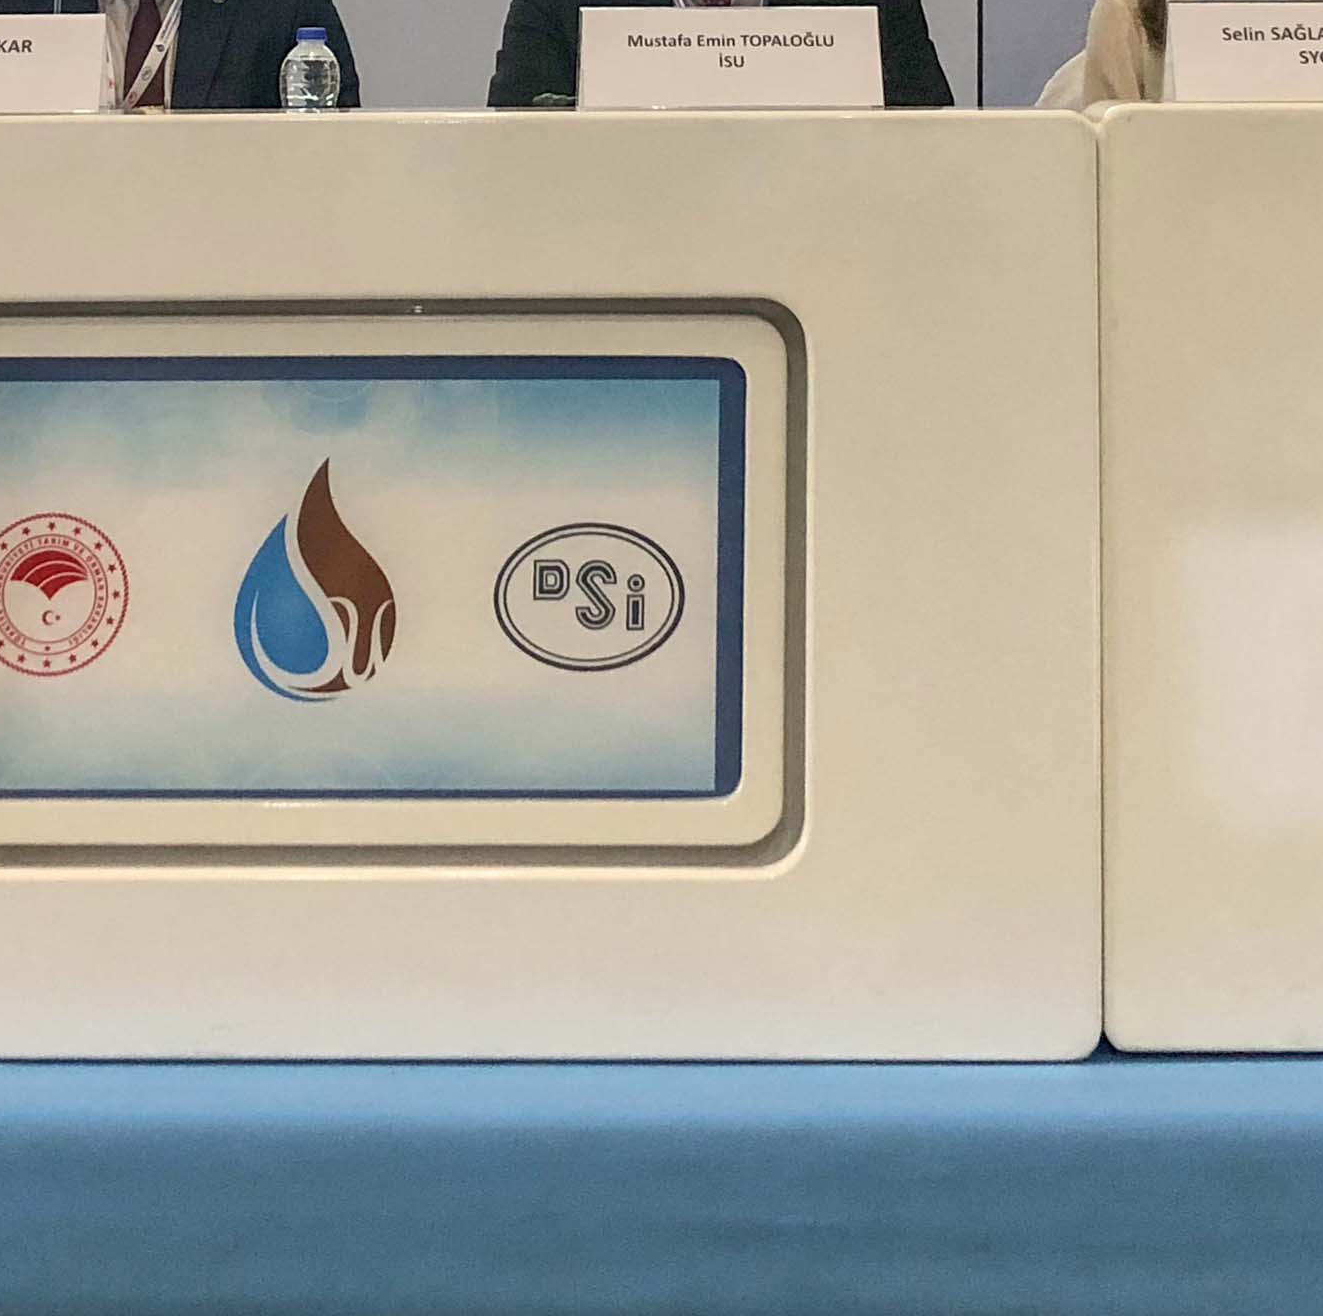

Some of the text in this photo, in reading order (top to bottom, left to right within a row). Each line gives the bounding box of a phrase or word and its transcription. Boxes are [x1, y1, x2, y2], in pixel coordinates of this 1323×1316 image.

[627, 31, 835, 48] Mustafa Emin TOPALOĞLU
[1222, 27, 1265, 41] Selin
[718, 52, 745, 68] İSU
